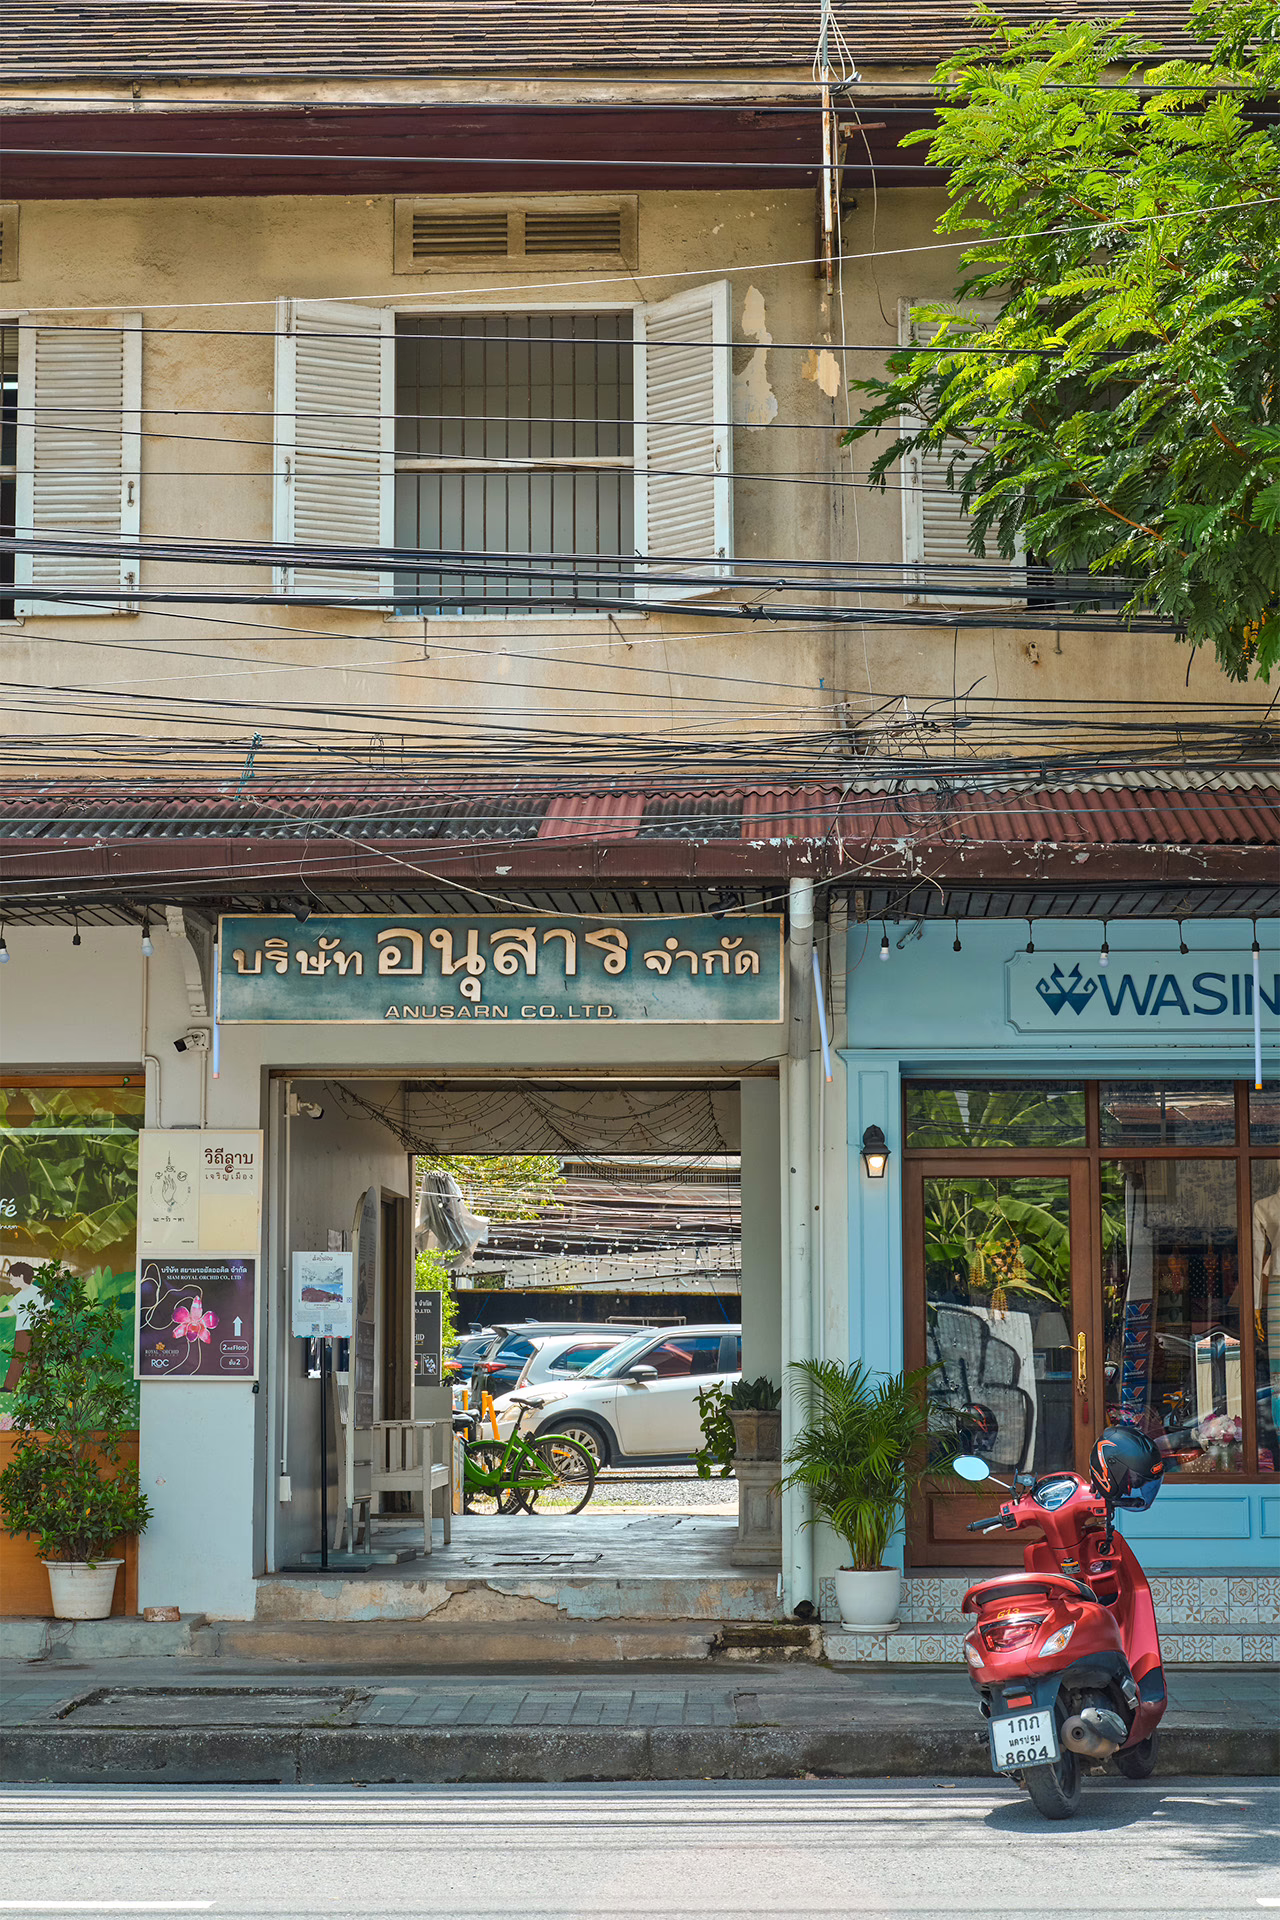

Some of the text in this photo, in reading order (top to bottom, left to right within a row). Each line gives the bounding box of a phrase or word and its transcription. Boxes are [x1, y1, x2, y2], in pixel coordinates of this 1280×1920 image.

[232, 926, 761, 1002] บริษัท อนุสาร จำกัด
[1097, 972, 1280, 1016] WASIN
[385, 1005, 508, 1018] ANUSARN
[205, 1148, 253, 1164] วิถีลาบ
[161, 1266, 179, 1274] บริษัท
[231, 1266, 248, 1274] จำกัด
[1009, 1734, 1041, 1747] นครปฐม
[1006, 1746, 1048, 1764] 8604
